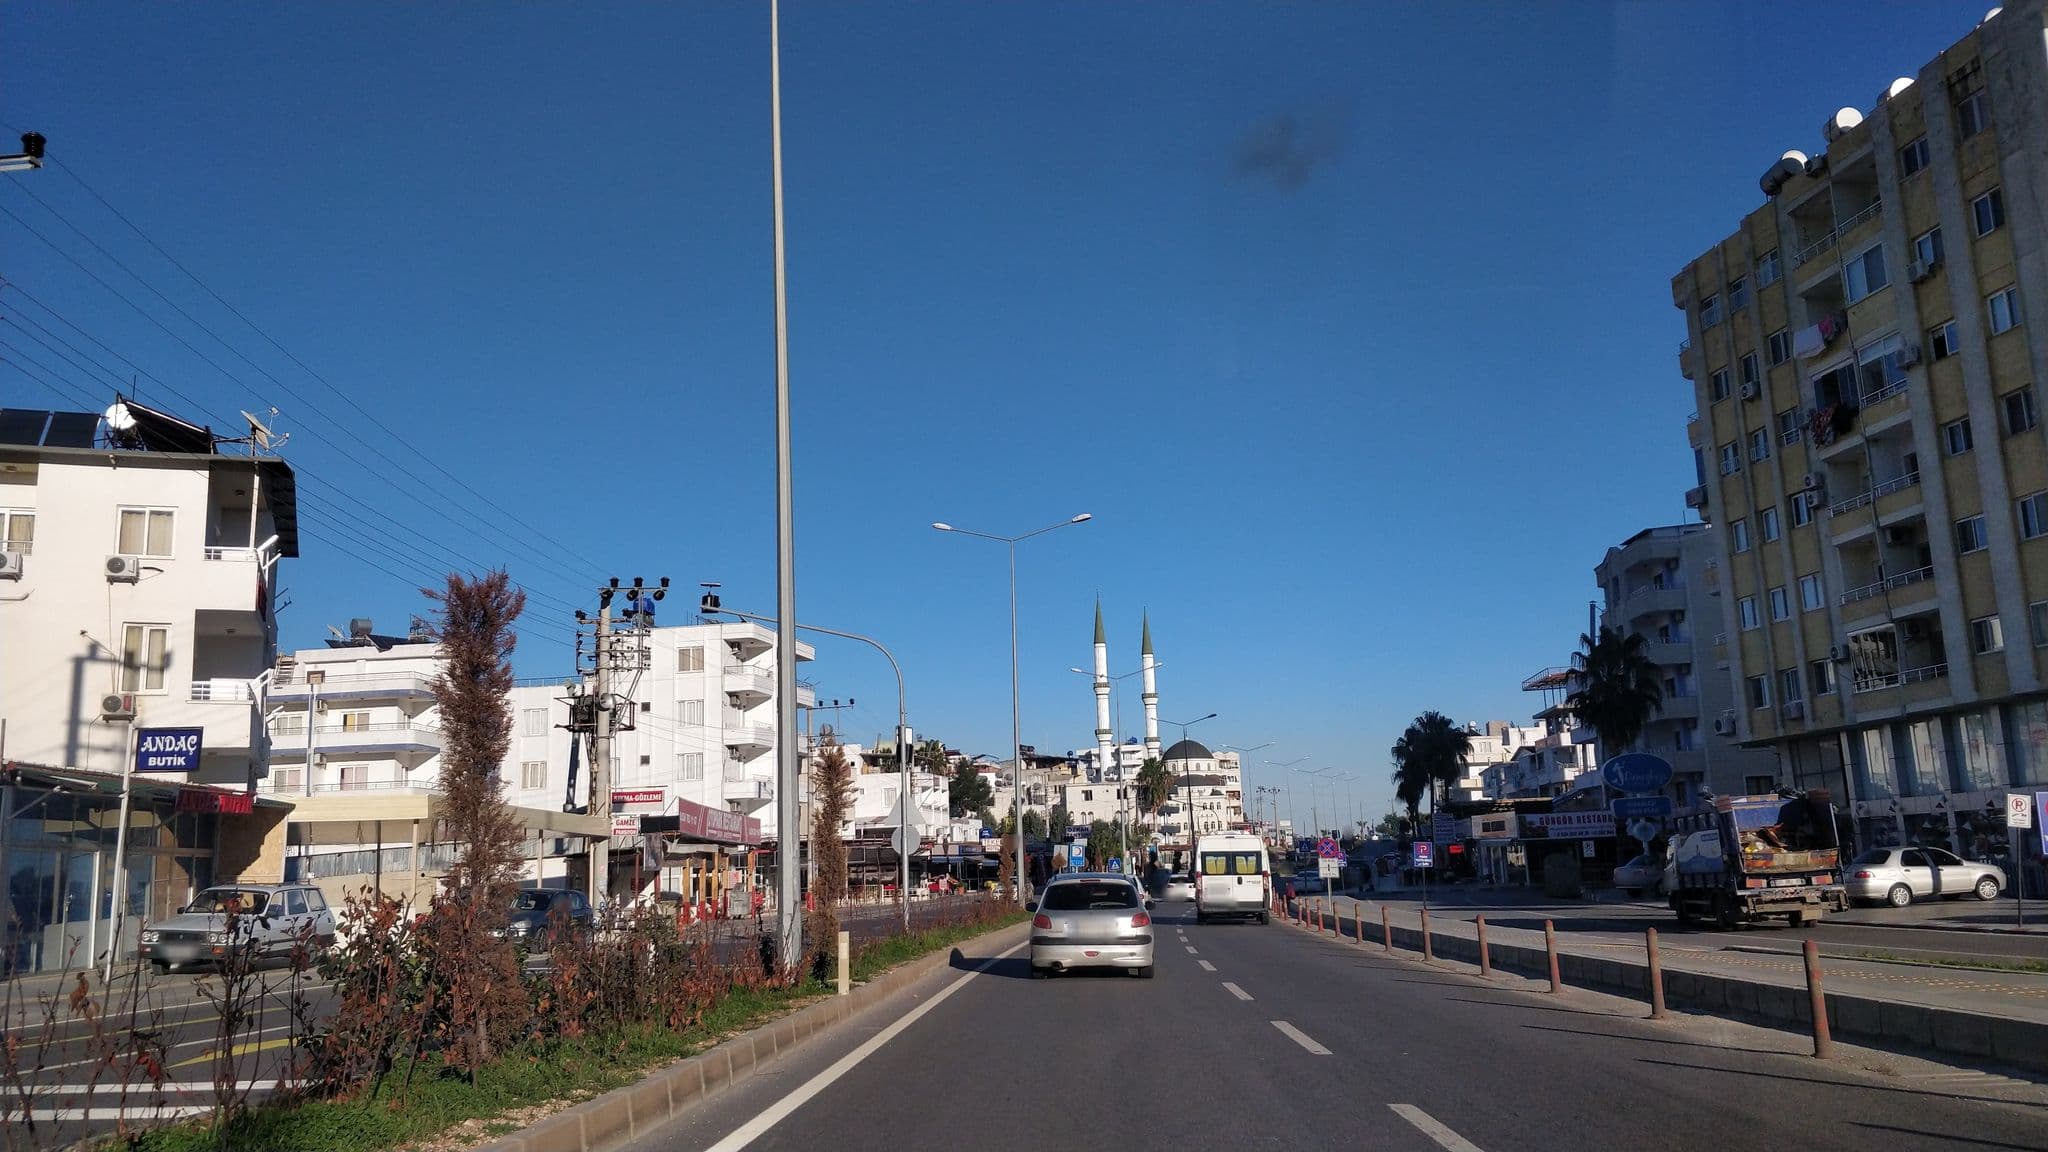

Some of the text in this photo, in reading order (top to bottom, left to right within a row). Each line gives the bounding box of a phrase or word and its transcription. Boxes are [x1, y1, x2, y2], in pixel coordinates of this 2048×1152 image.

[141, 735, 197, 755] ANDAÇ
[148, 754, 186, 766] BUTİK
[615, 818, 636, 826] GAMZE
